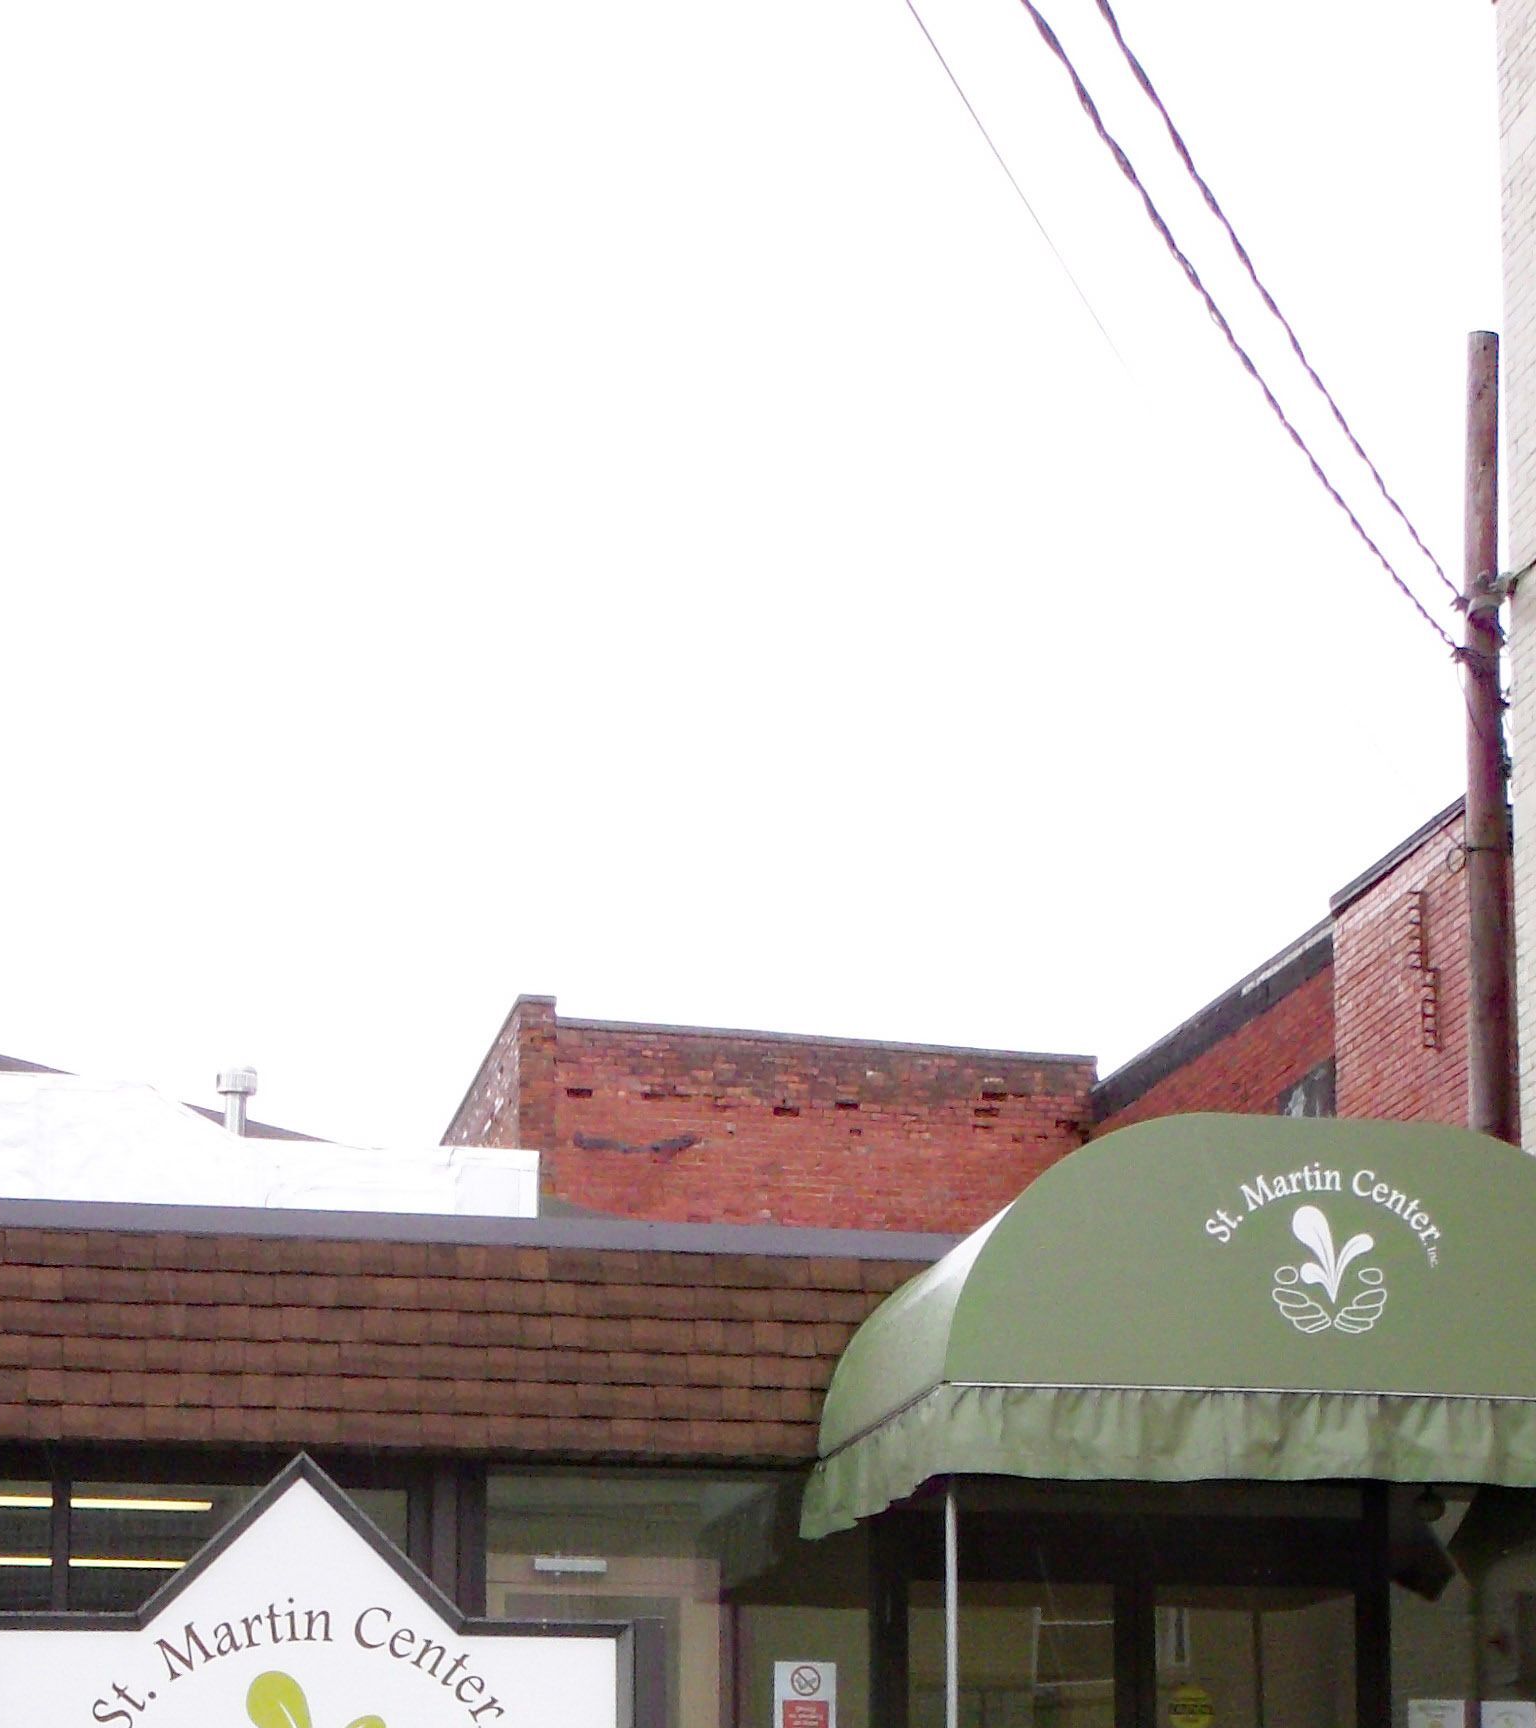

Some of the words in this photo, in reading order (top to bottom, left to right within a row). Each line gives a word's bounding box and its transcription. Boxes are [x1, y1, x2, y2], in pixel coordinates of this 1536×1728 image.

[1205, 1208, 1244, 1243] St.
[1240, 1161, 1342, 1212] Martin
[154, 1597, 334, 1681] Martin
